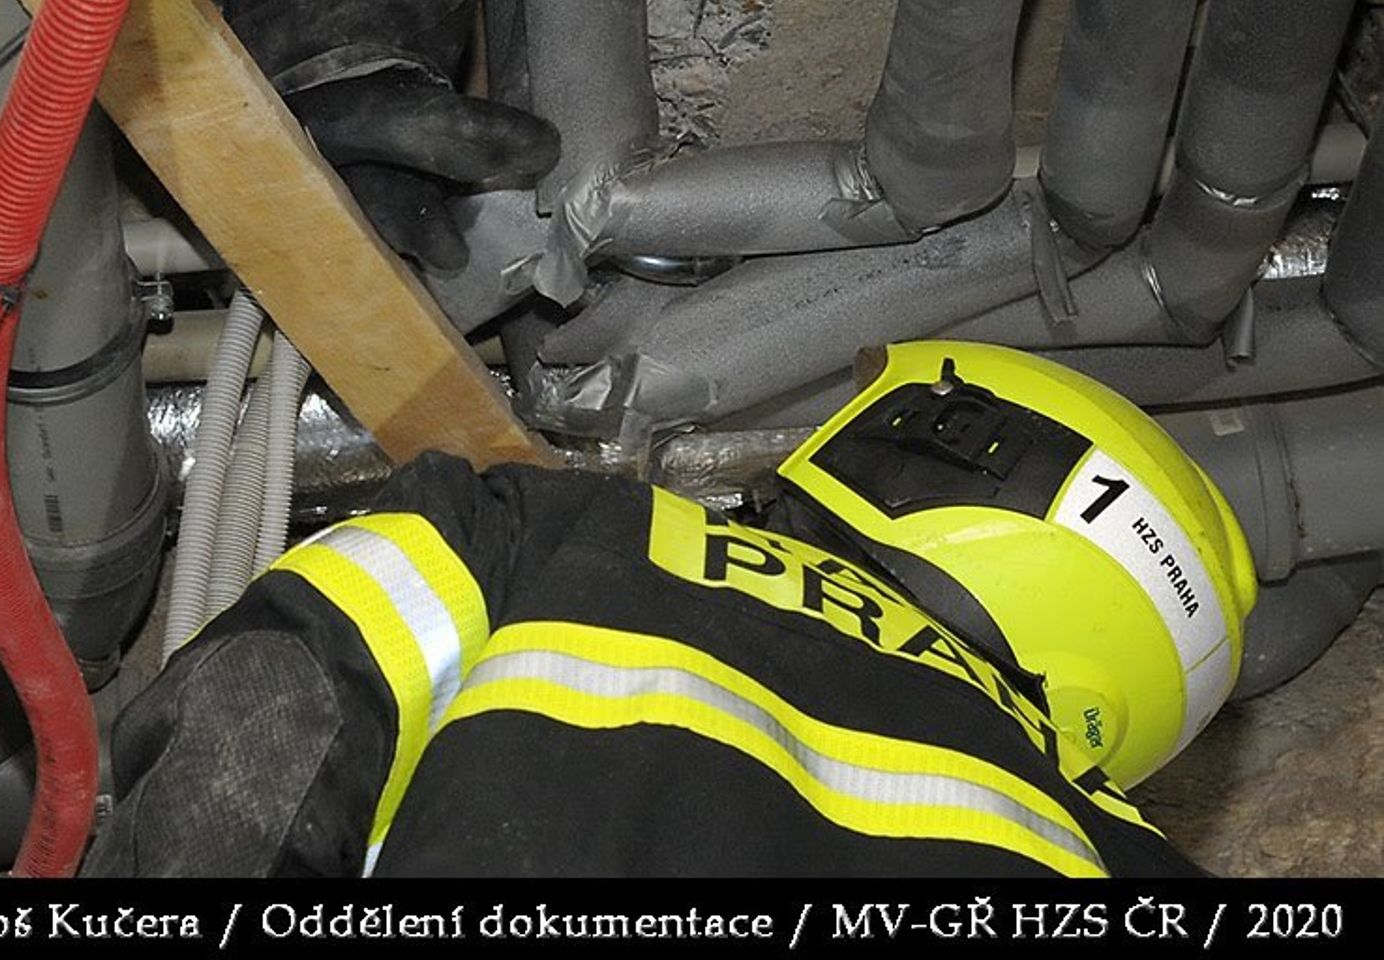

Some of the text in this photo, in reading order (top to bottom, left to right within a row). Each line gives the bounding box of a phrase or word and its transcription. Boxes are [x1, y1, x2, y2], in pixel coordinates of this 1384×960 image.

[1080, 474, 1130, 525] 1
[1131, 516, 1200, 619] HZS PRAHA
